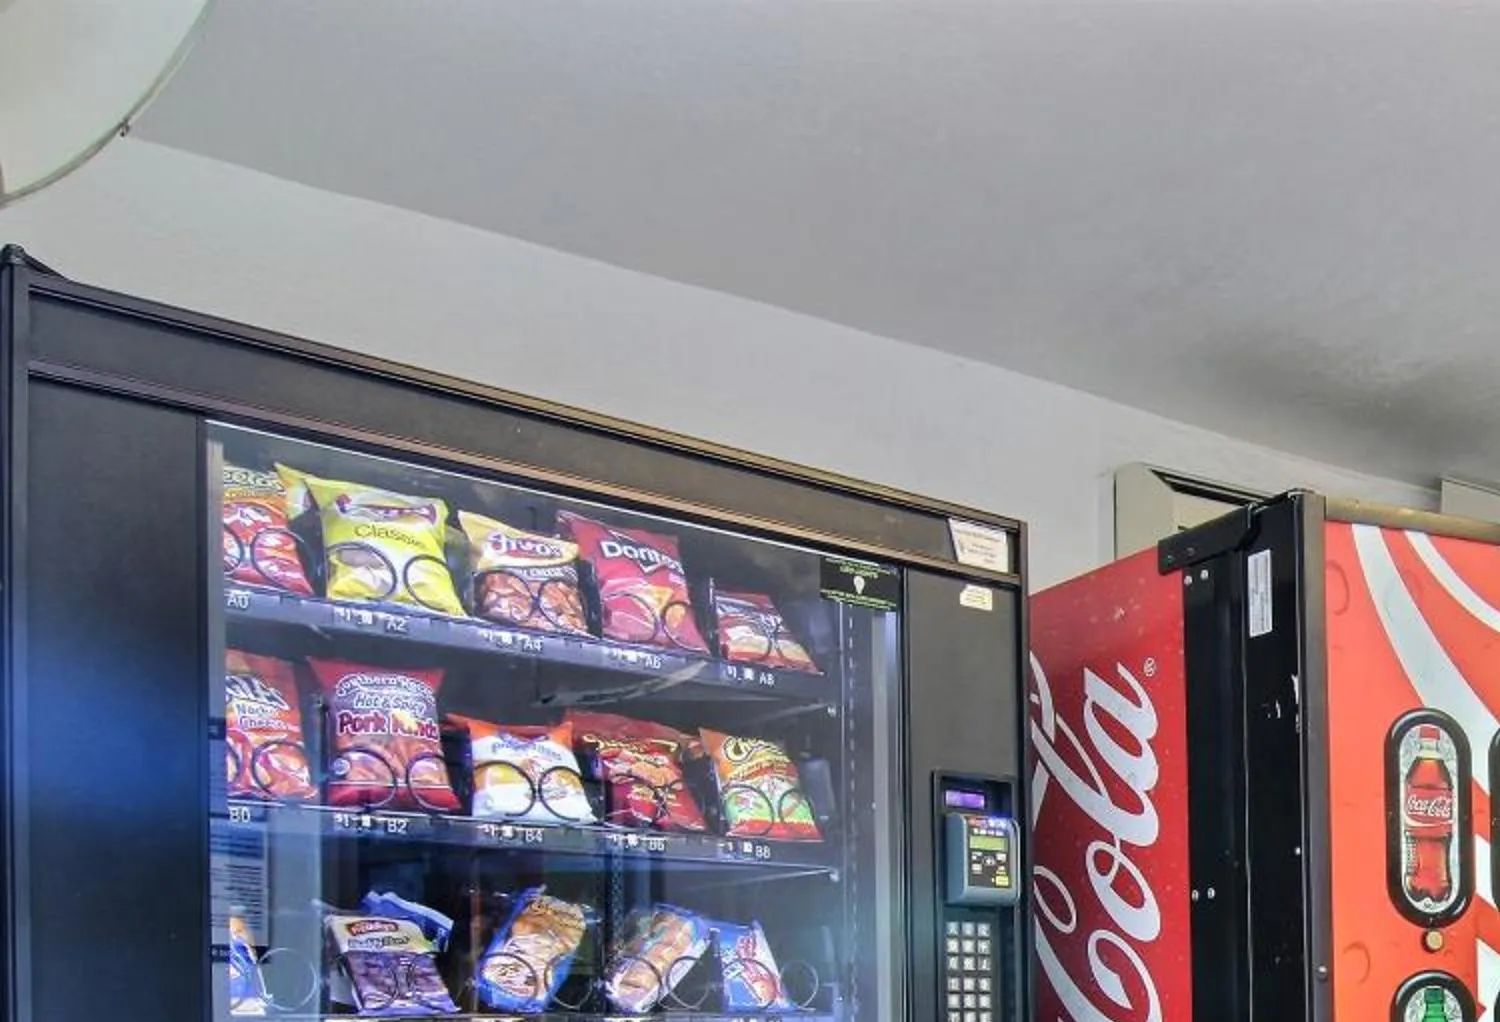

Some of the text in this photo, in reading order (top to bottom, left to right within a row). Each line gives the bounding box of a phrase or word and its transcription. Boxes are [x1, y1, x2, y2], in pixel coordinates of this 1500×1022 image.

[354, 523, 429, 548] Classic
[600, 539, 685, 576] Doritos
[227, 592, 250, 609] A0
[386, 617, 408, 632] A2
[522, 637, 543, 652] A4
[353, 691, 382, 709] Hot
[390, 695, 427, 717] Spicy
[336, 708, 440, 743] Pork Rinds
[228, 807, 250, 823] B0
[1406, 793, 1454, 818] Coca-Cola
[387, 819, 408, 834] B2
